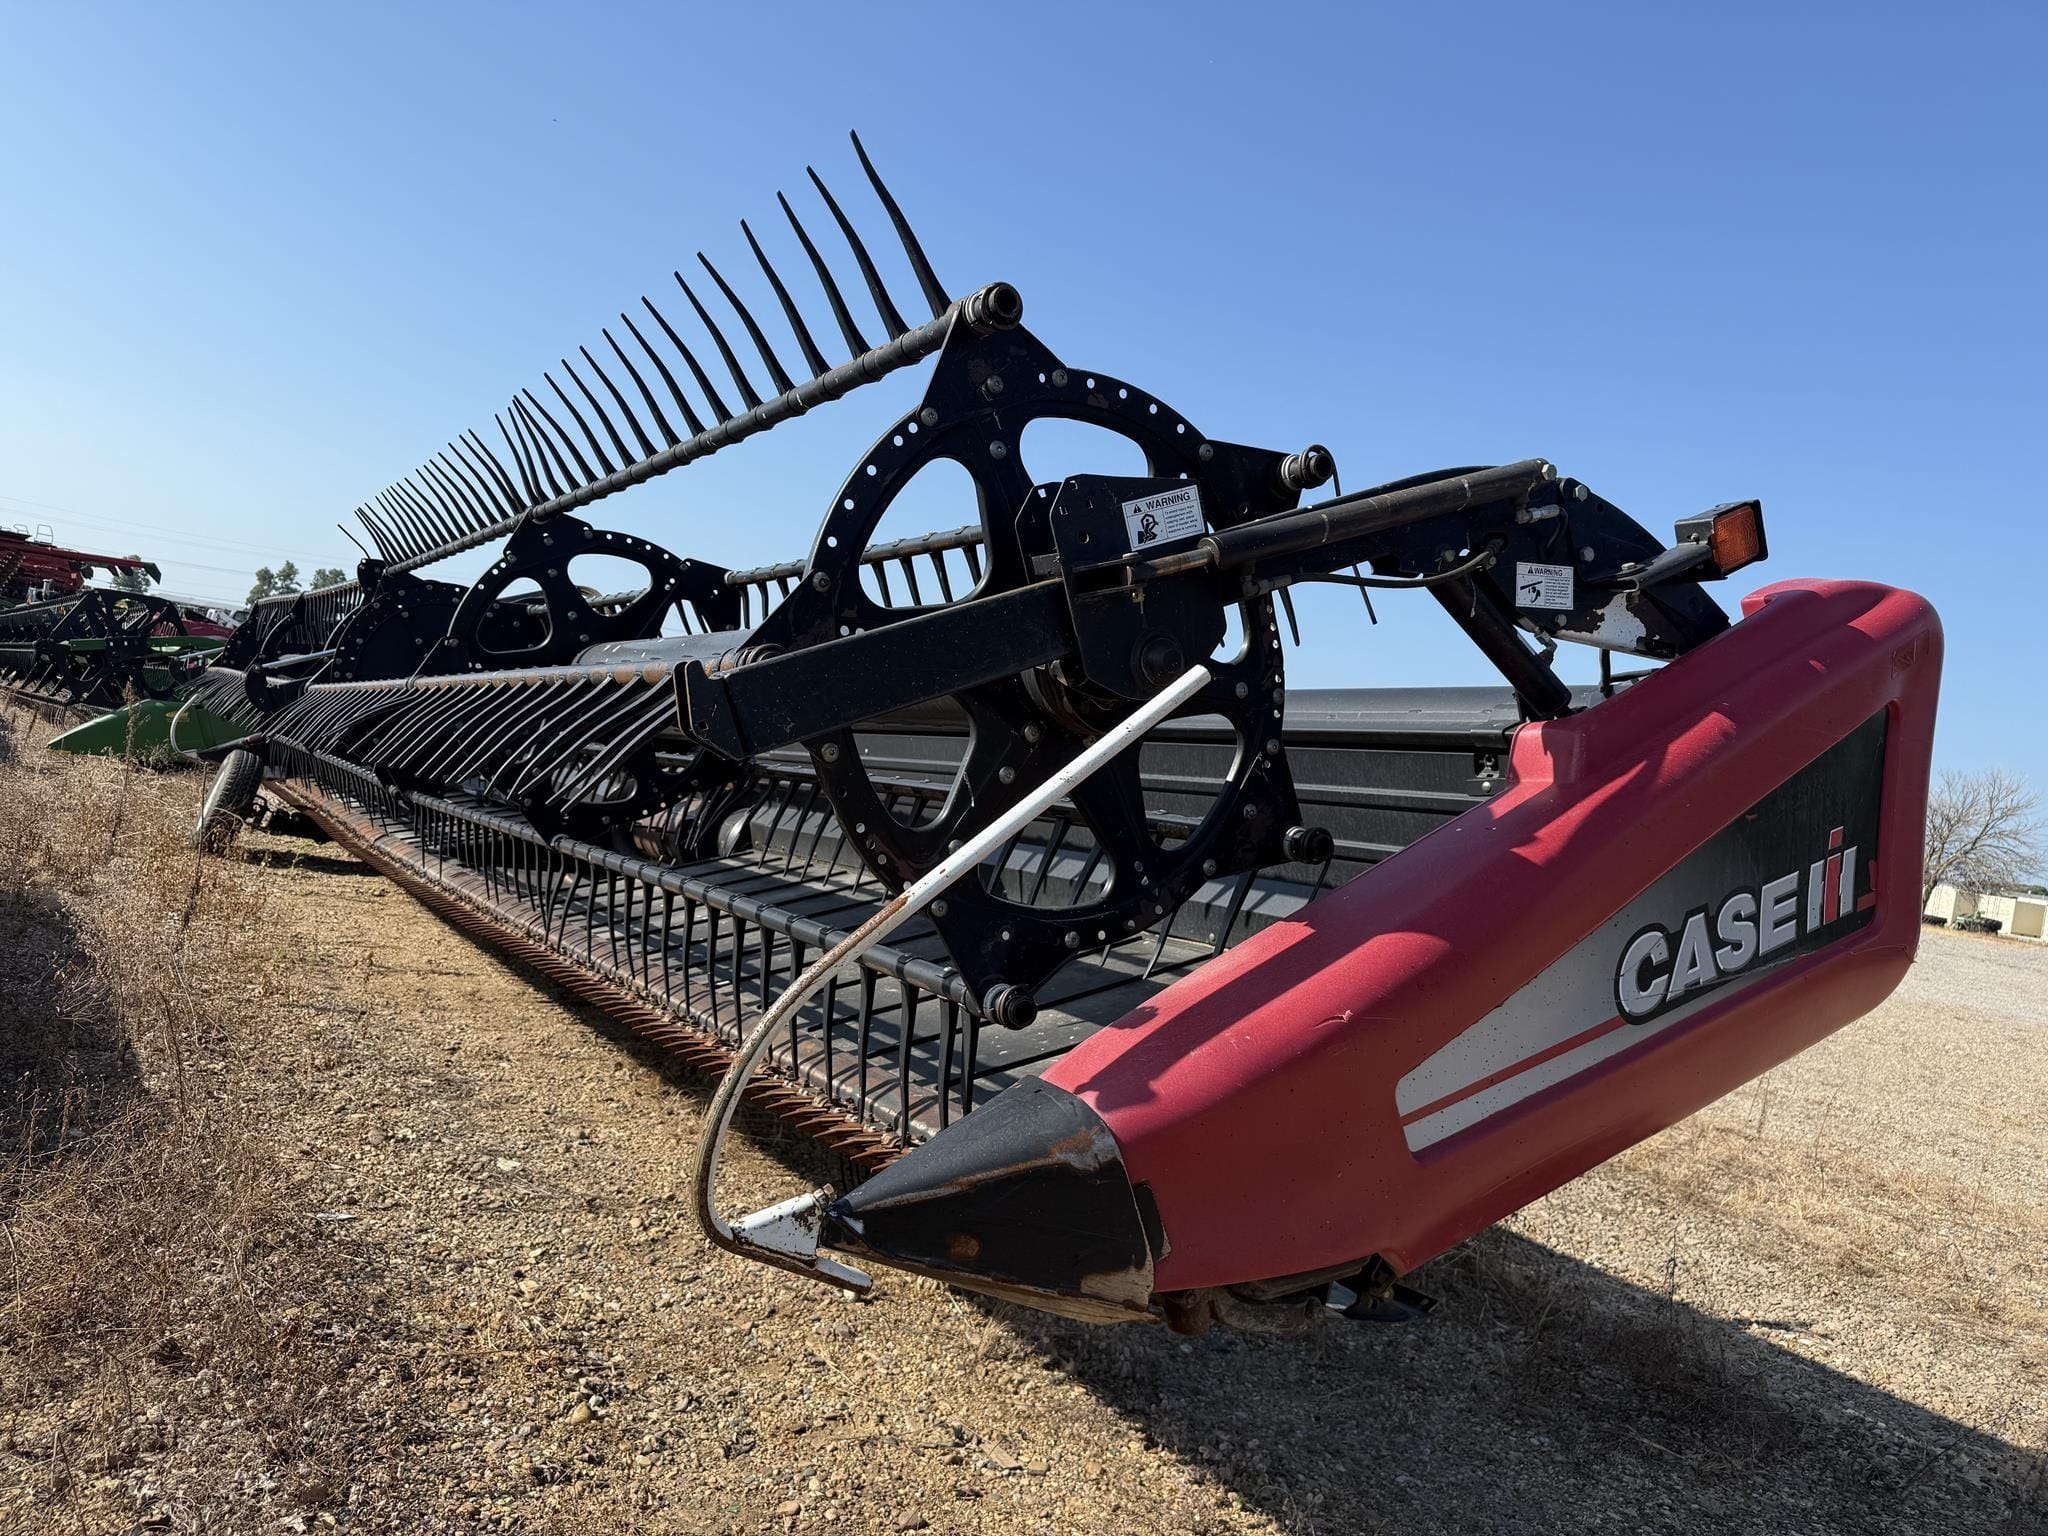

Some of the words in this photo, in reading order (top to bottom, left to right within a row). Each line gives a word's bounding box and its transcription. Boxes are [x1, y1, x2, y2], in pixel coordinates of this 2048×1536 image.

[1146, 492, 1191, 510] WARNING
[1534, 567, 1563, 577] WARNING
[1619, 870, 1799, 1016] CASE
